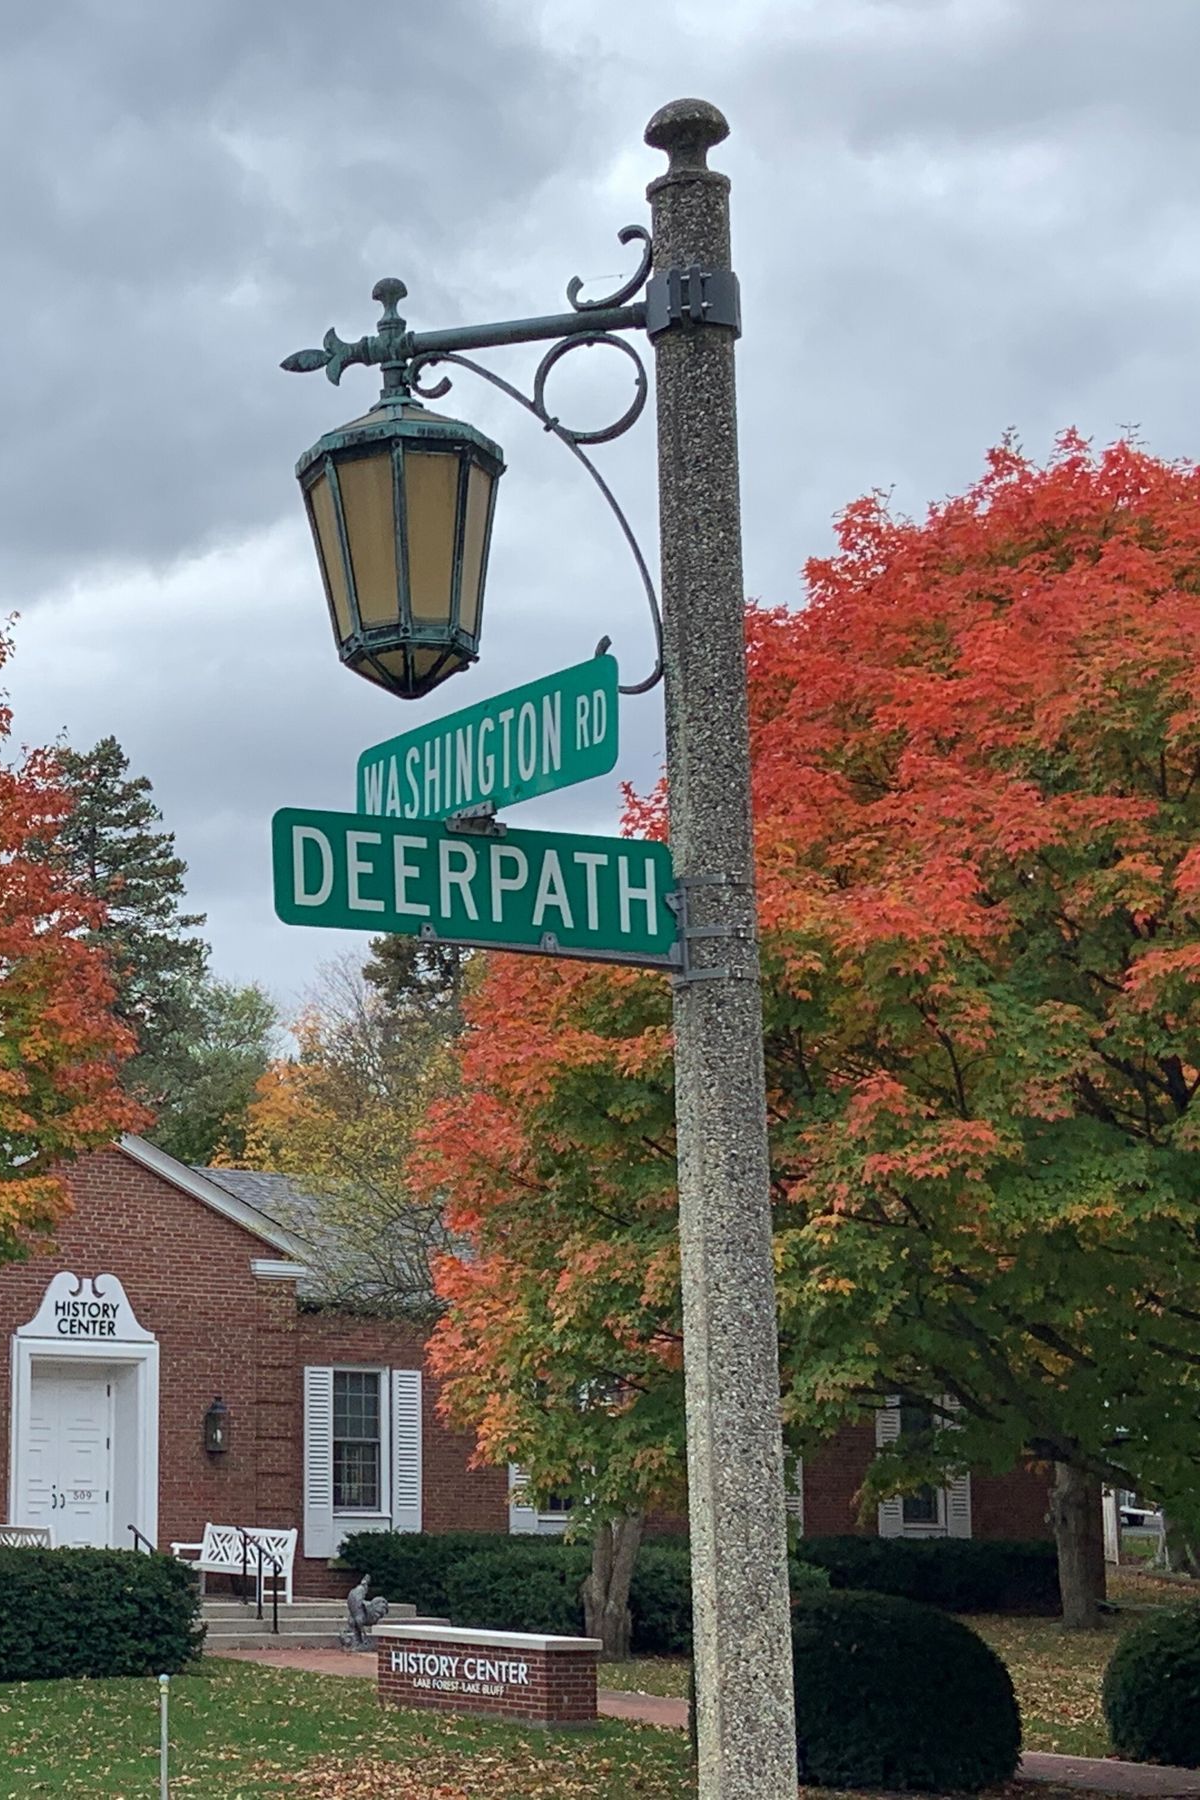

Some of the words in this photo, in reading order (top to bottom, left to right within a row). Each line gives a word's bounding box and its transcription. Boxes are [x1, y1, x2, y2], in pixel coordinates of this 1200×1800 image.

[364, 691, 562, 819] WASHINGTON
[576, 689, 607, 750] RD
[292, 825, 658, 935] DEERPATH
[55, 1300, 119, 1318] HISTORY
[57, 1318, 116, 1336] CENTER
[73, 1490, 93, 1500] 509
[391, 1651, 459, 1677] HISTORY
[464, 1658, 529, 1684] CENTER
[413, 1678, 431, 1689] LAKE
[482, 1684, 505, 1696] BLUFF
